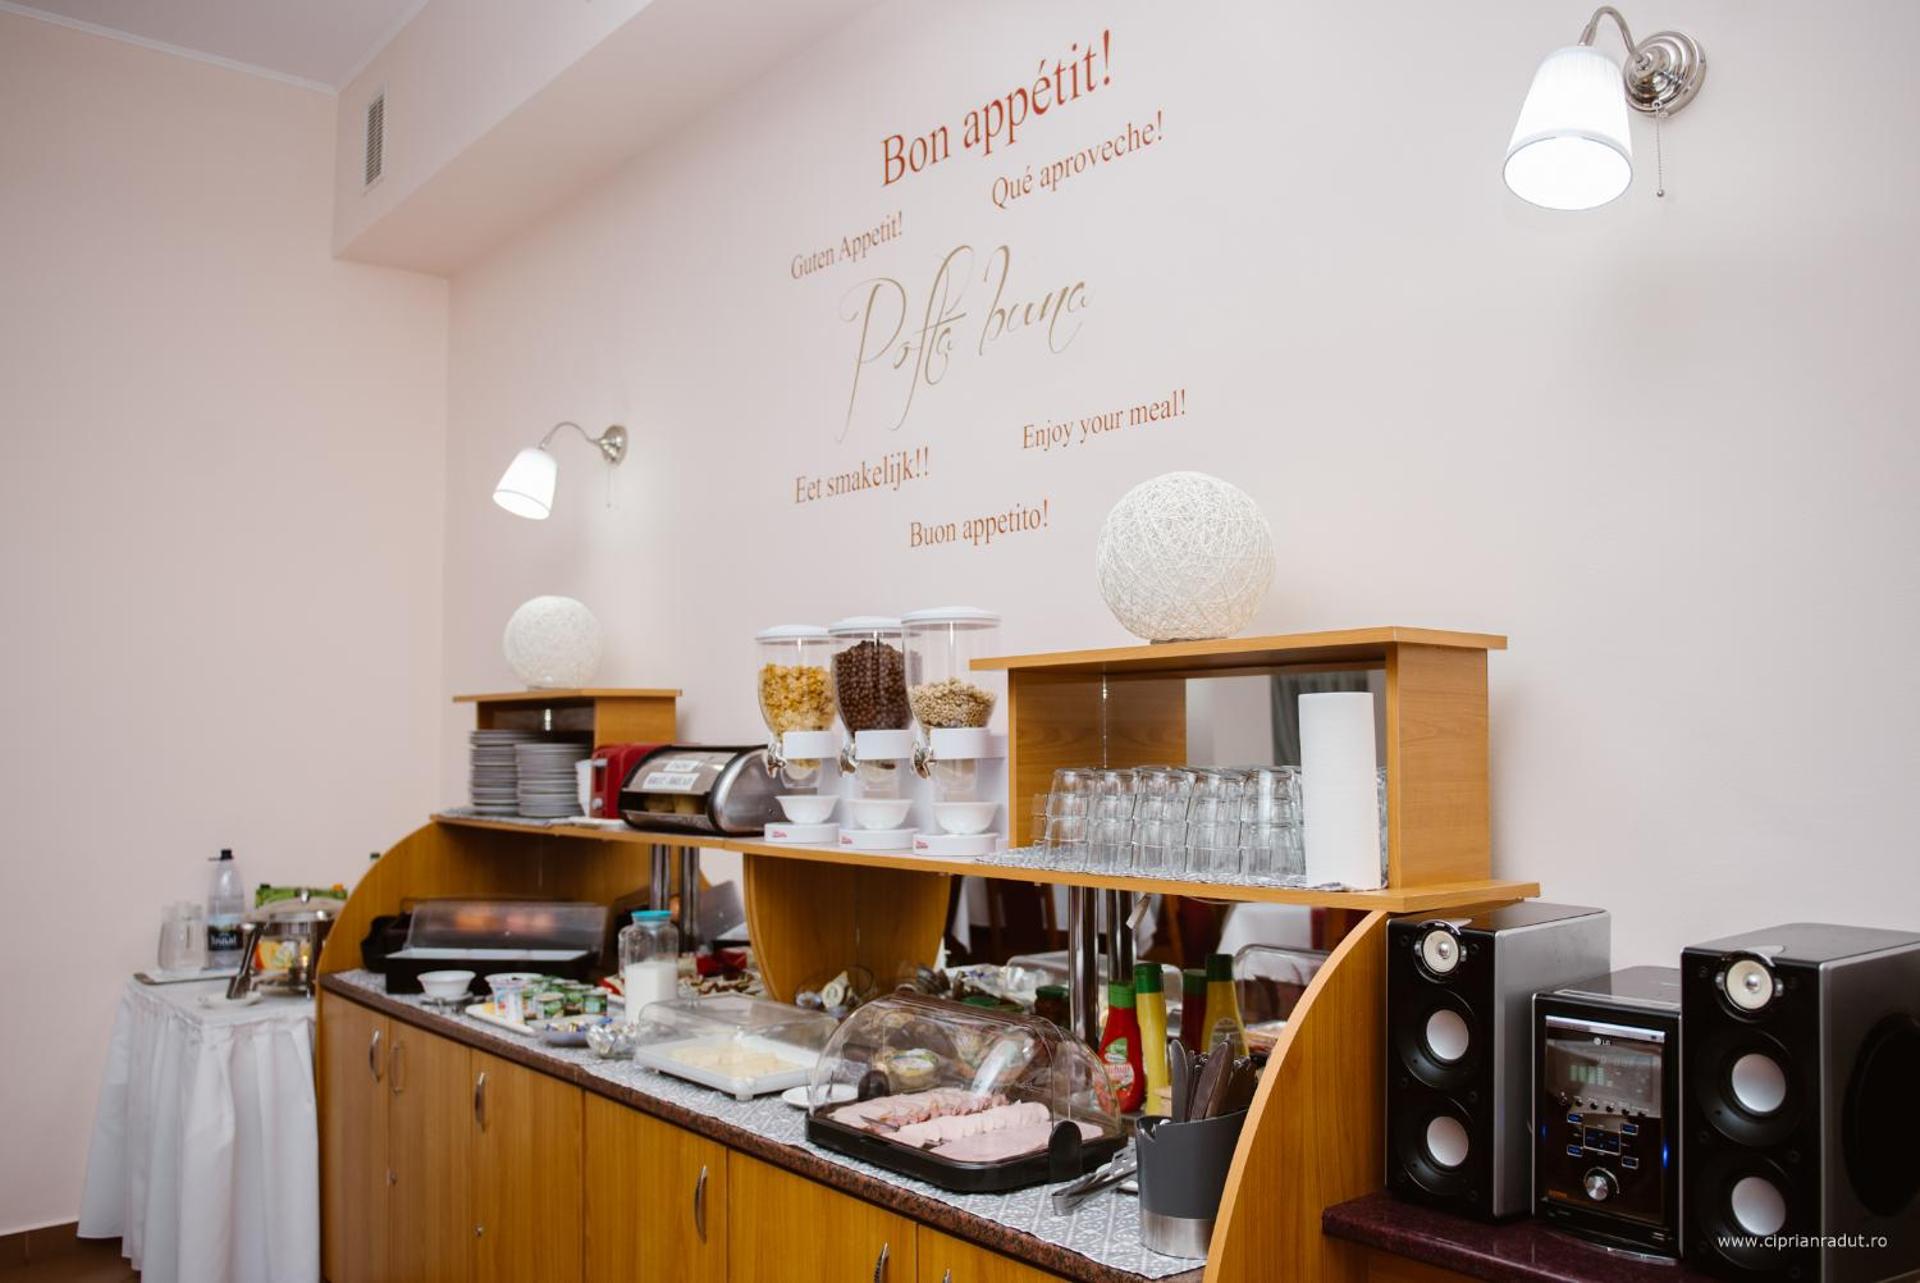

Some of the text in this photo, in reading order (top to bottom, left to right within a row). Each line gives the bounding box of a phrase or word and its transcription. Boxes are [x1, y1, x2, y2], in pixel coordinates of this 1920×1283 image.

[880, 29, 1113, 187] Bon appétit!
[991, 110, 1164, 209] Qué aproveche!
[791, 210, 903, 279] Guten Appetit!
[1023, 388, 1186, 452] Enjoy your meal!
[795, 446, 929, 504] Eet smakelijk!!
[910, 498, 1048, 548] Buon appetito!
